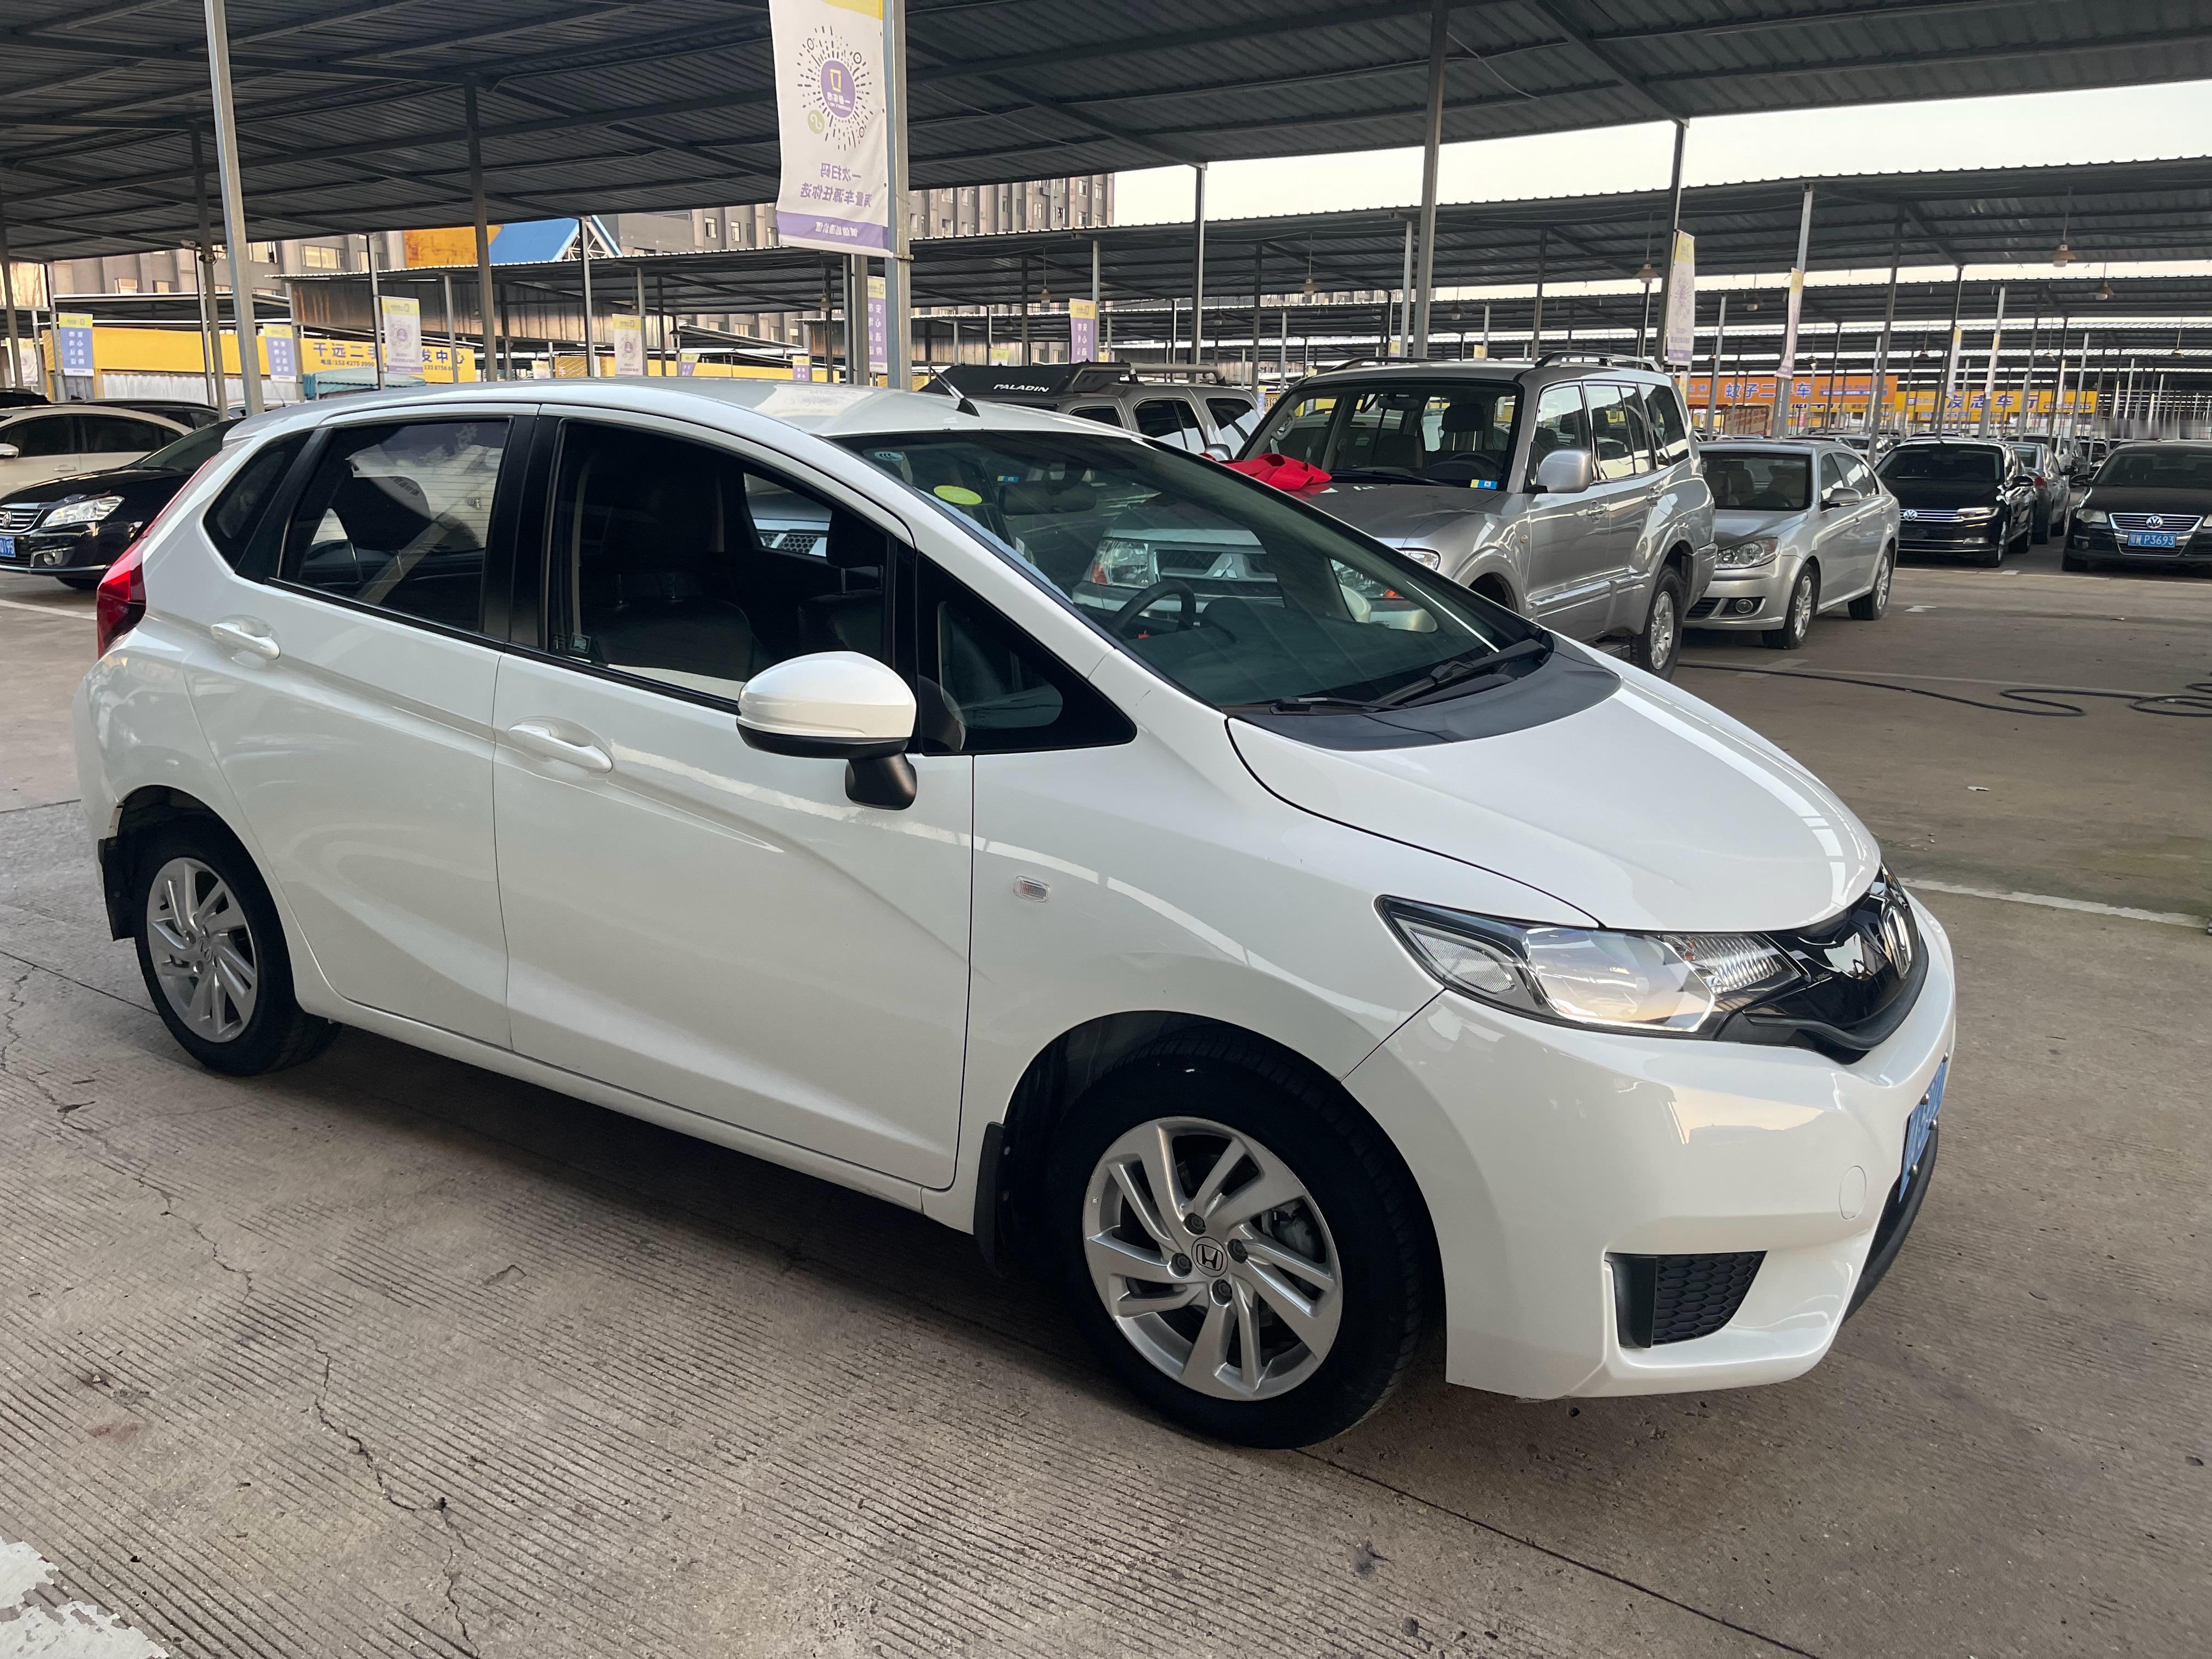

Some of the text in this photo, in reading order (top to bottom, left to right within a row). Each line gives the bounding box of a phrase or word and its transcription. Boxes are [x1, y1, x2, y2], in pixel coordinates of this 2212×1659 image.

[993, 384, 1049, 392] PALADIN
[1725, 382, 1812, 399] 蚊子二车
